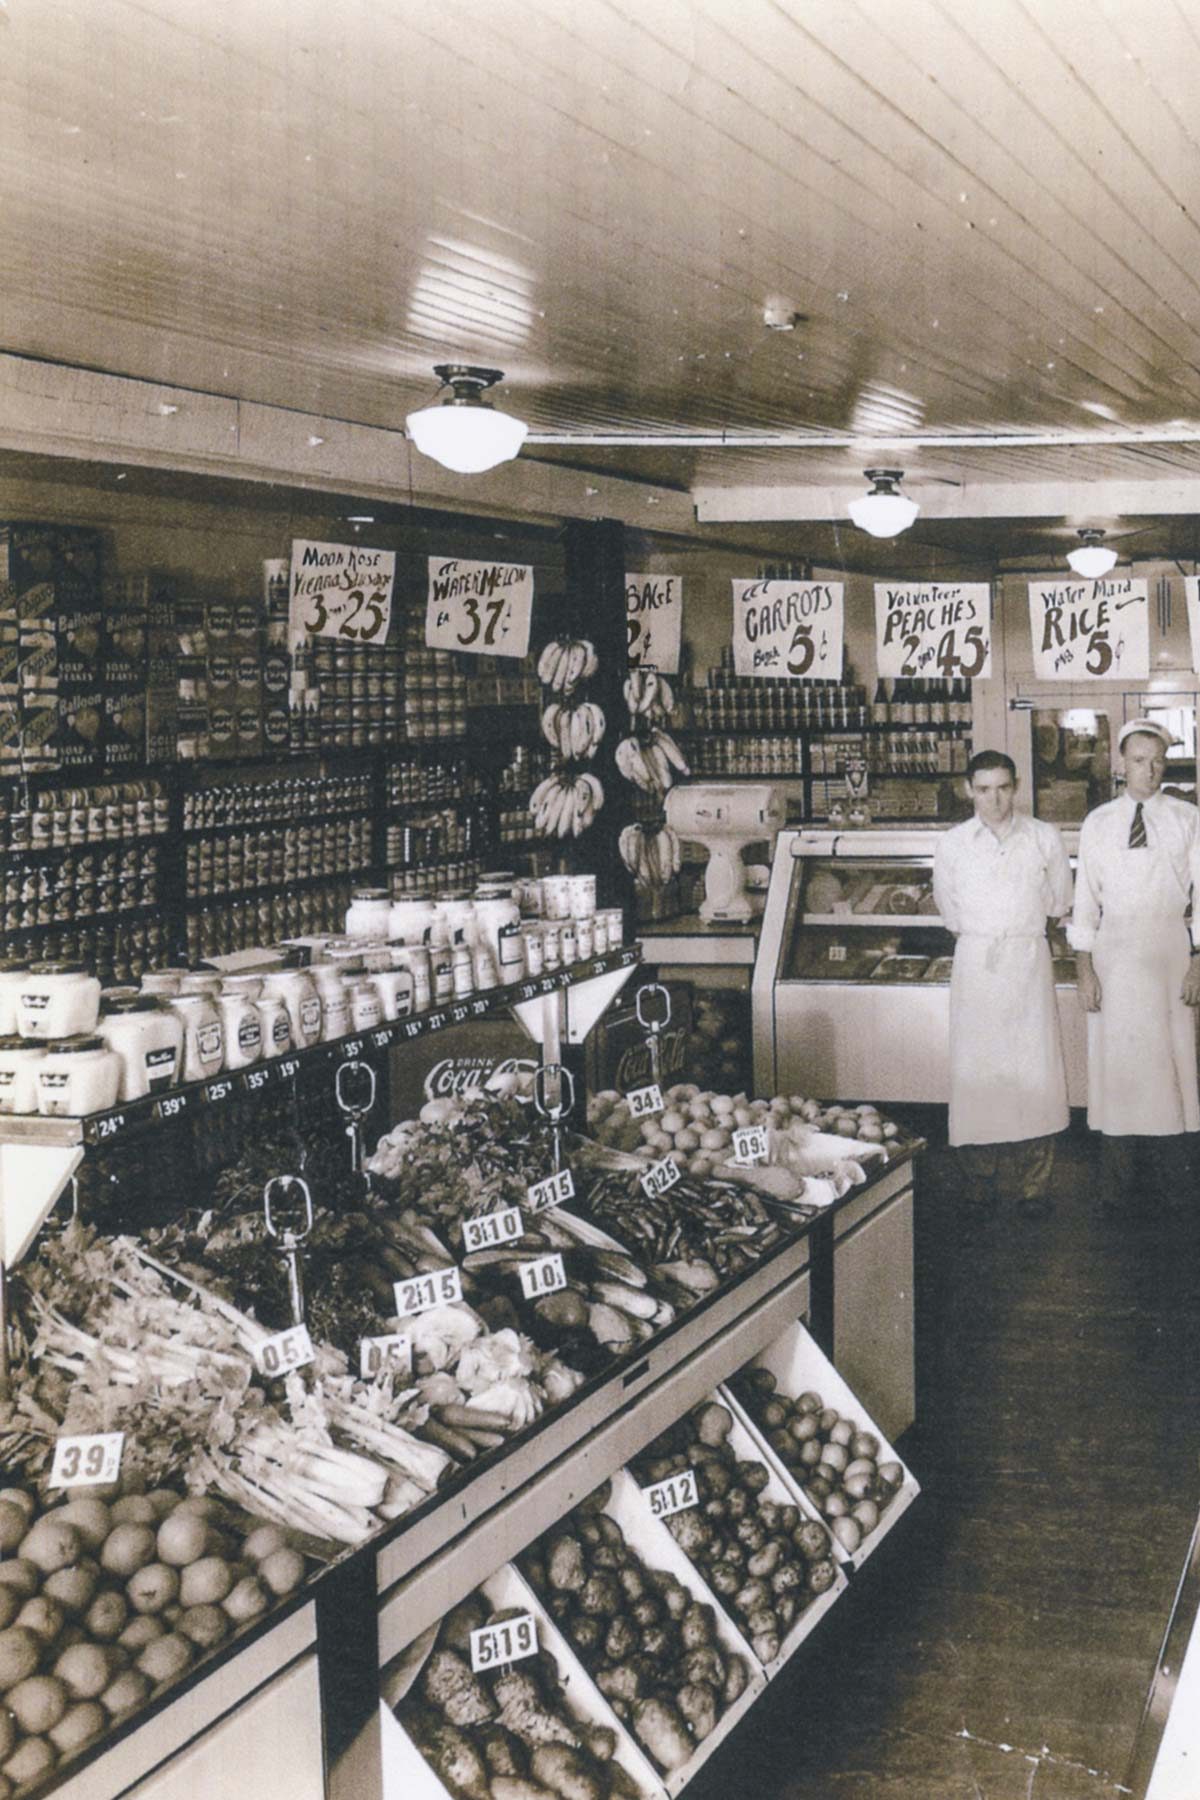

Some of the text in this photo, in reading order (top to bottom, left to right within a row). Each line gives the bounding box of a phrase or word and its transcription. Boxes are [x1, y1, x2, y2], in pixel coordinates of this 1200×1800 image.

[304, 593, 328, 634] 3
[626, 579, 674, 614] BAGE
[745, 584, 833, 642] CARROTS
[60, 611, 103, 633] Balloon
[883, 600, 977, 646] PEACHES
[1041, 601, 1111, 653] RICE
[901, 635, 921, 677] 2
[424, 1058, 541, 1102] Coca-C
[457, 1058, 496, 1067] DRINK
[469, 1214, 517, 1247] 3 10
[402, 1274, 456, 1311] 2 15
[528, 1264, 556, 1292] 10
[61, 1444, 105, 1480] 39
[650, 1479, 693, 1515] 5 12
[478, 1622, 531, 1664] 5 19
